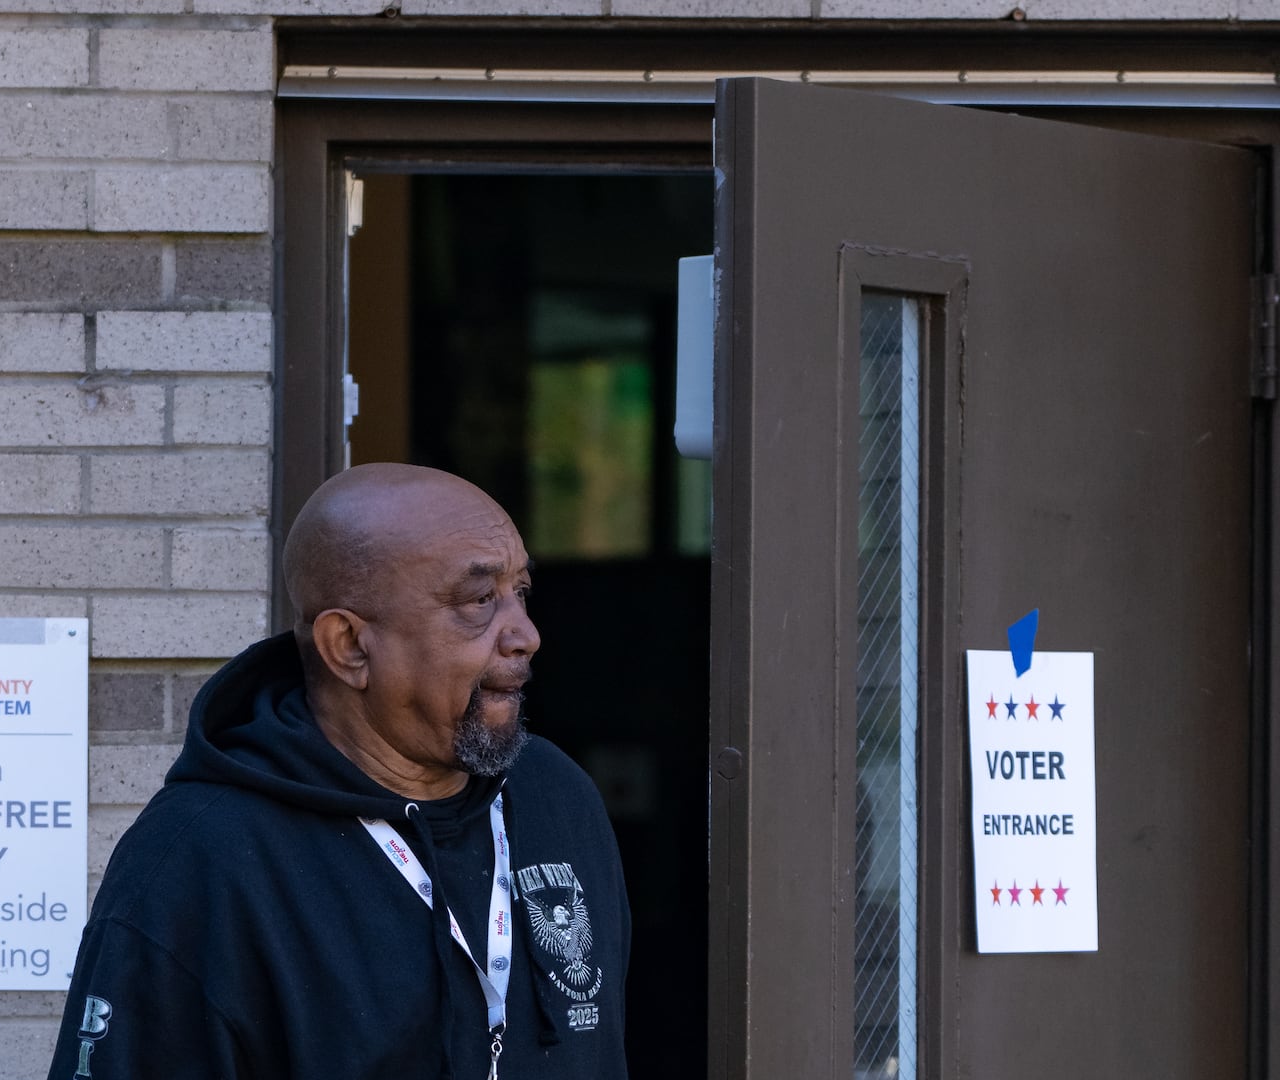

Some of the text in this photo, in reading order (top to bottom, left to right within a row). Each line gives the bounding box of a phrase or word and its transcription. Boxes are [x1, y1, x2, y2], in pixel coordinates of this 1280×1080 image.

[986, 750, 1066, 780] VOTER
[984, 815, 1074, 836] ENTRANCE
[548, 966, 603, 1002] DAYTONA BEACH
[567, 1007, 599, 1027] 2025
